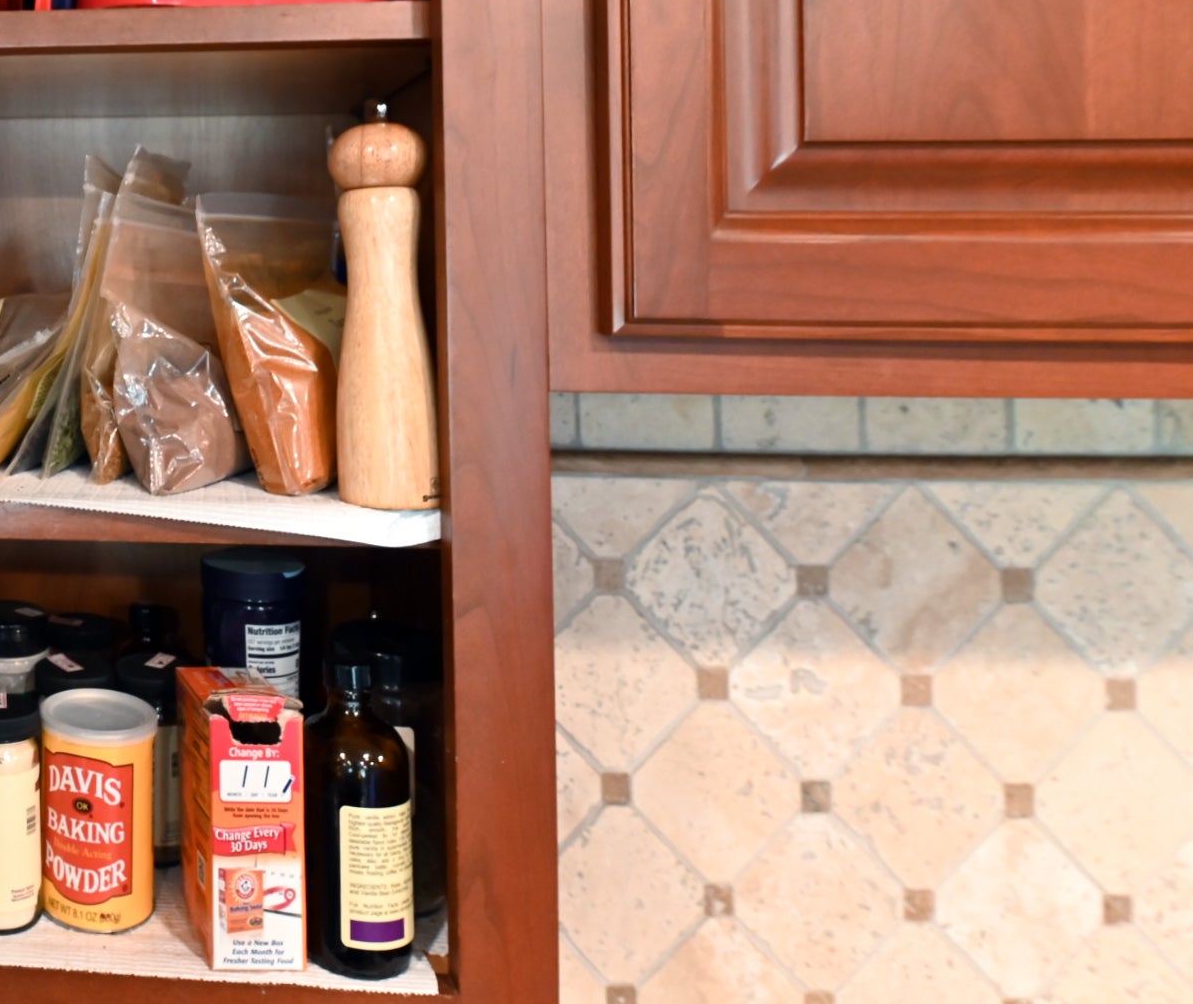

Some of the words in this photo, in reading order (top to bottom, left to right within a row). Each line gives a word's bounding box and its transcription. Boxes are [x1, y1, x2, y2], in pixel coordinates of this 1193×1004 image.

[247, 626, 283, 637] Nutrition
[229, 747, 264, 761] Change
[48, 764, 122, 807] DAVIS
[76, 801, 89, 811] OK
[47, 806, 126, 845] BAKING
[214, 829, 252, 844] Change
[253, 826, 279, 841] Every
[231, 840, 242, 852] 30
[244, 840, 268, 853] Days
[81, 848, 113, 861] Acting
[46, 838, 128, 894] POWDER
[60, 902, 71, 915] WT
[85, 910, 98, 923] OZ
[223, 957, 248, 965] Fresher
[250, 957, 275, 966] Tasting
